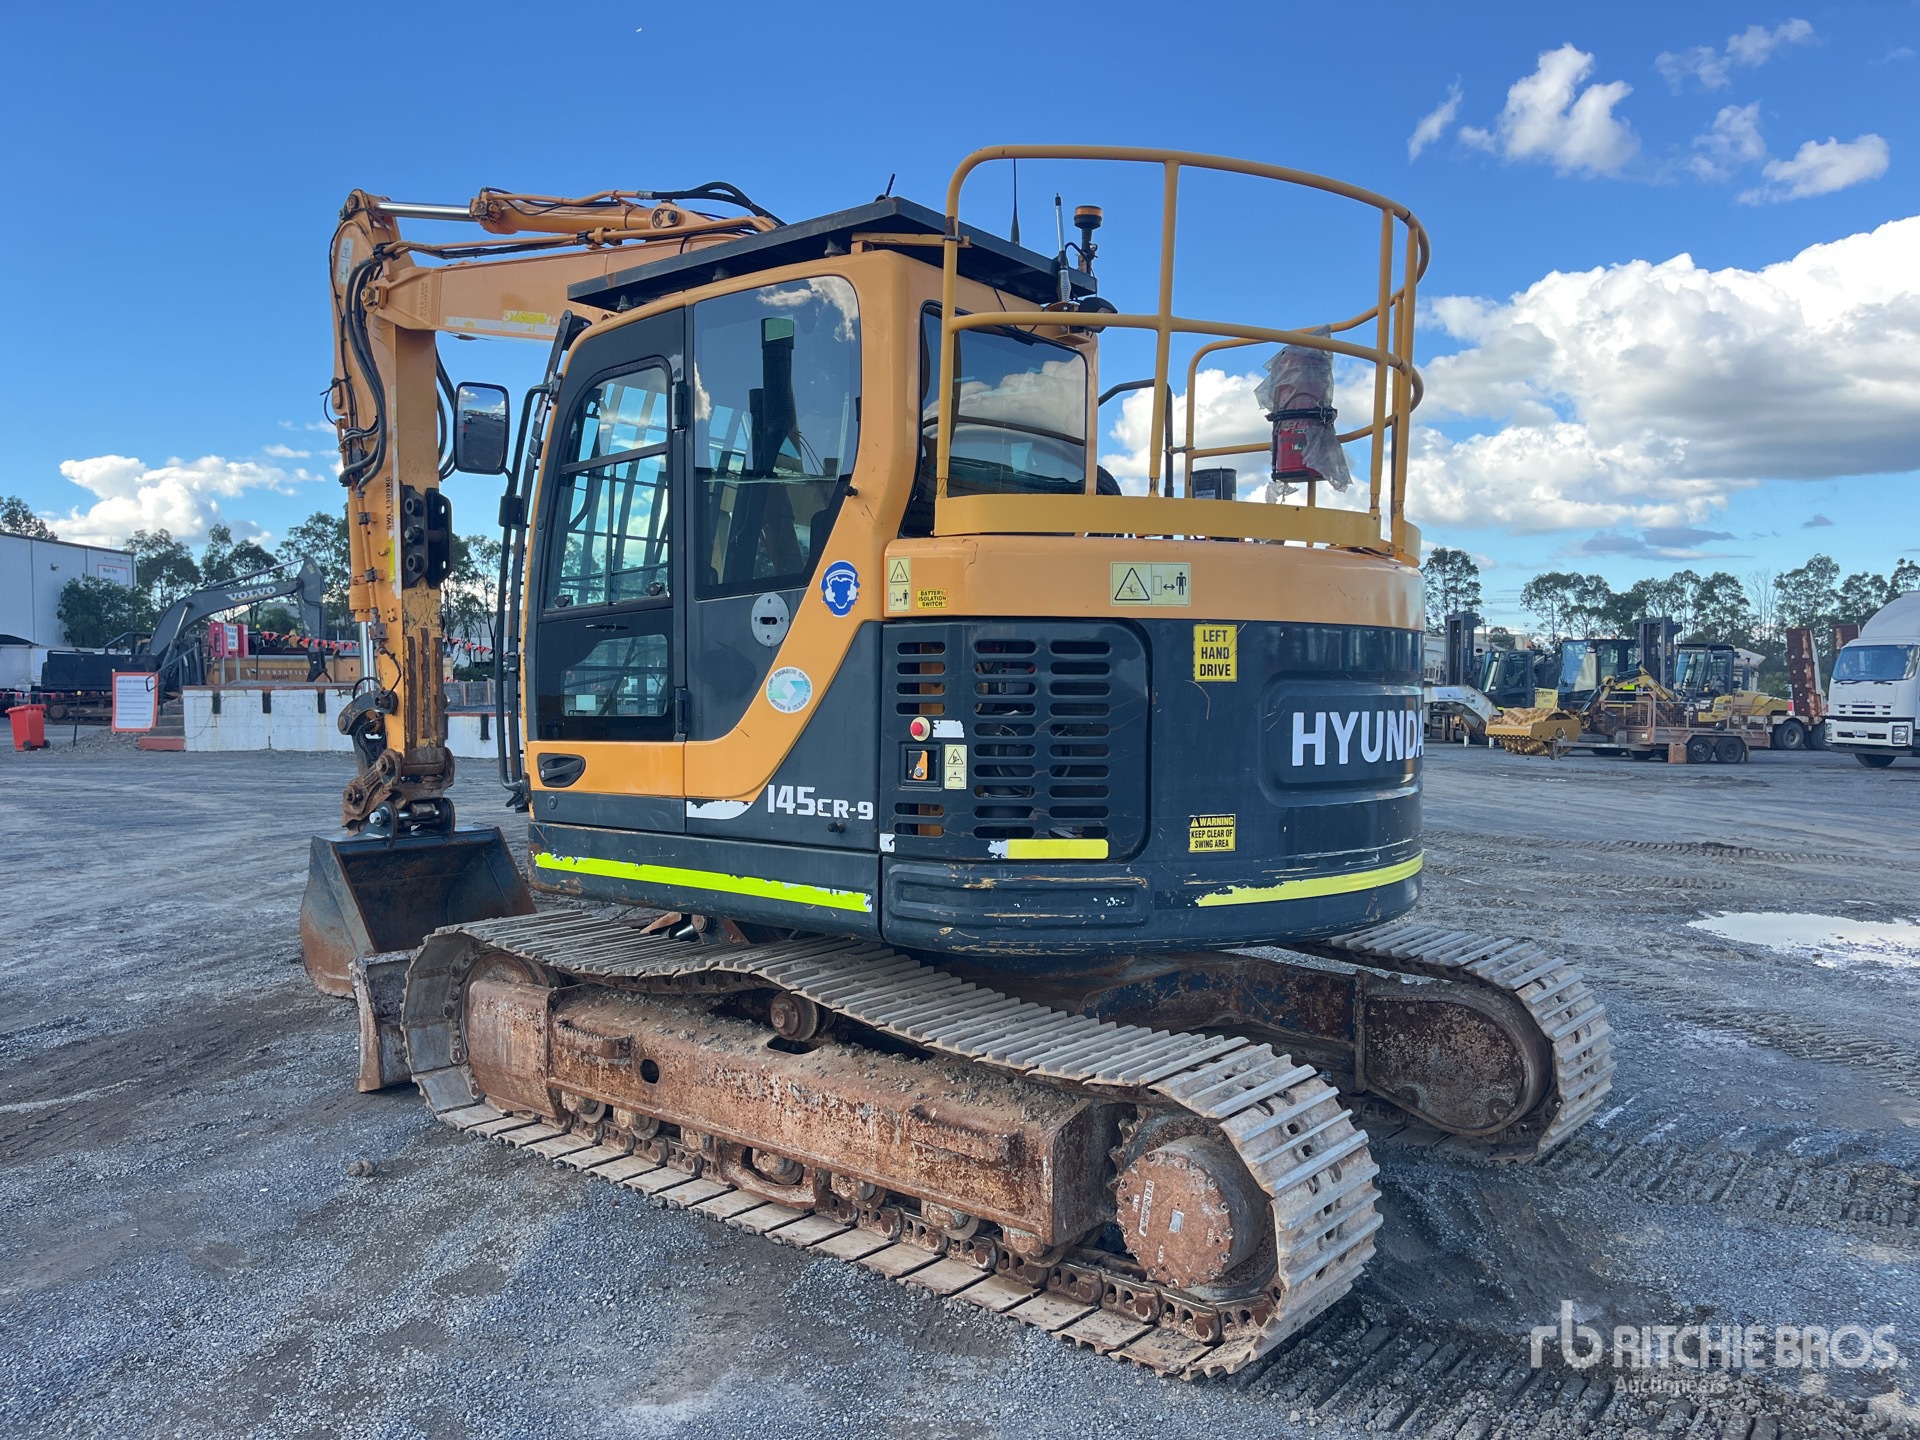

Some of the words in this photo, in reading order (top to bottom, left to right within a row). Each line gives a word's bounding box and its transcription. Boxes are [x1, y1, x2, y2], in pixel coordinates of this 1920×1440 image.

[226, 586, 276, 601] VOLVO
[1203, 630, 1227, 642] LEFT
[1201, 646, 1230, 659] HAND
[1200, 663, 1231, 676] DRIVE
[1199, 816, 1234, 827] WARNING
[1191, 829, 1206, 838] KEEP
[1207, 829, 1225, 838] CLEAR
[1225, 828, 1233, 837] OF
[1194, 839, 1213, 848] SWING
[1214, 839, 1229, 847] AREA
